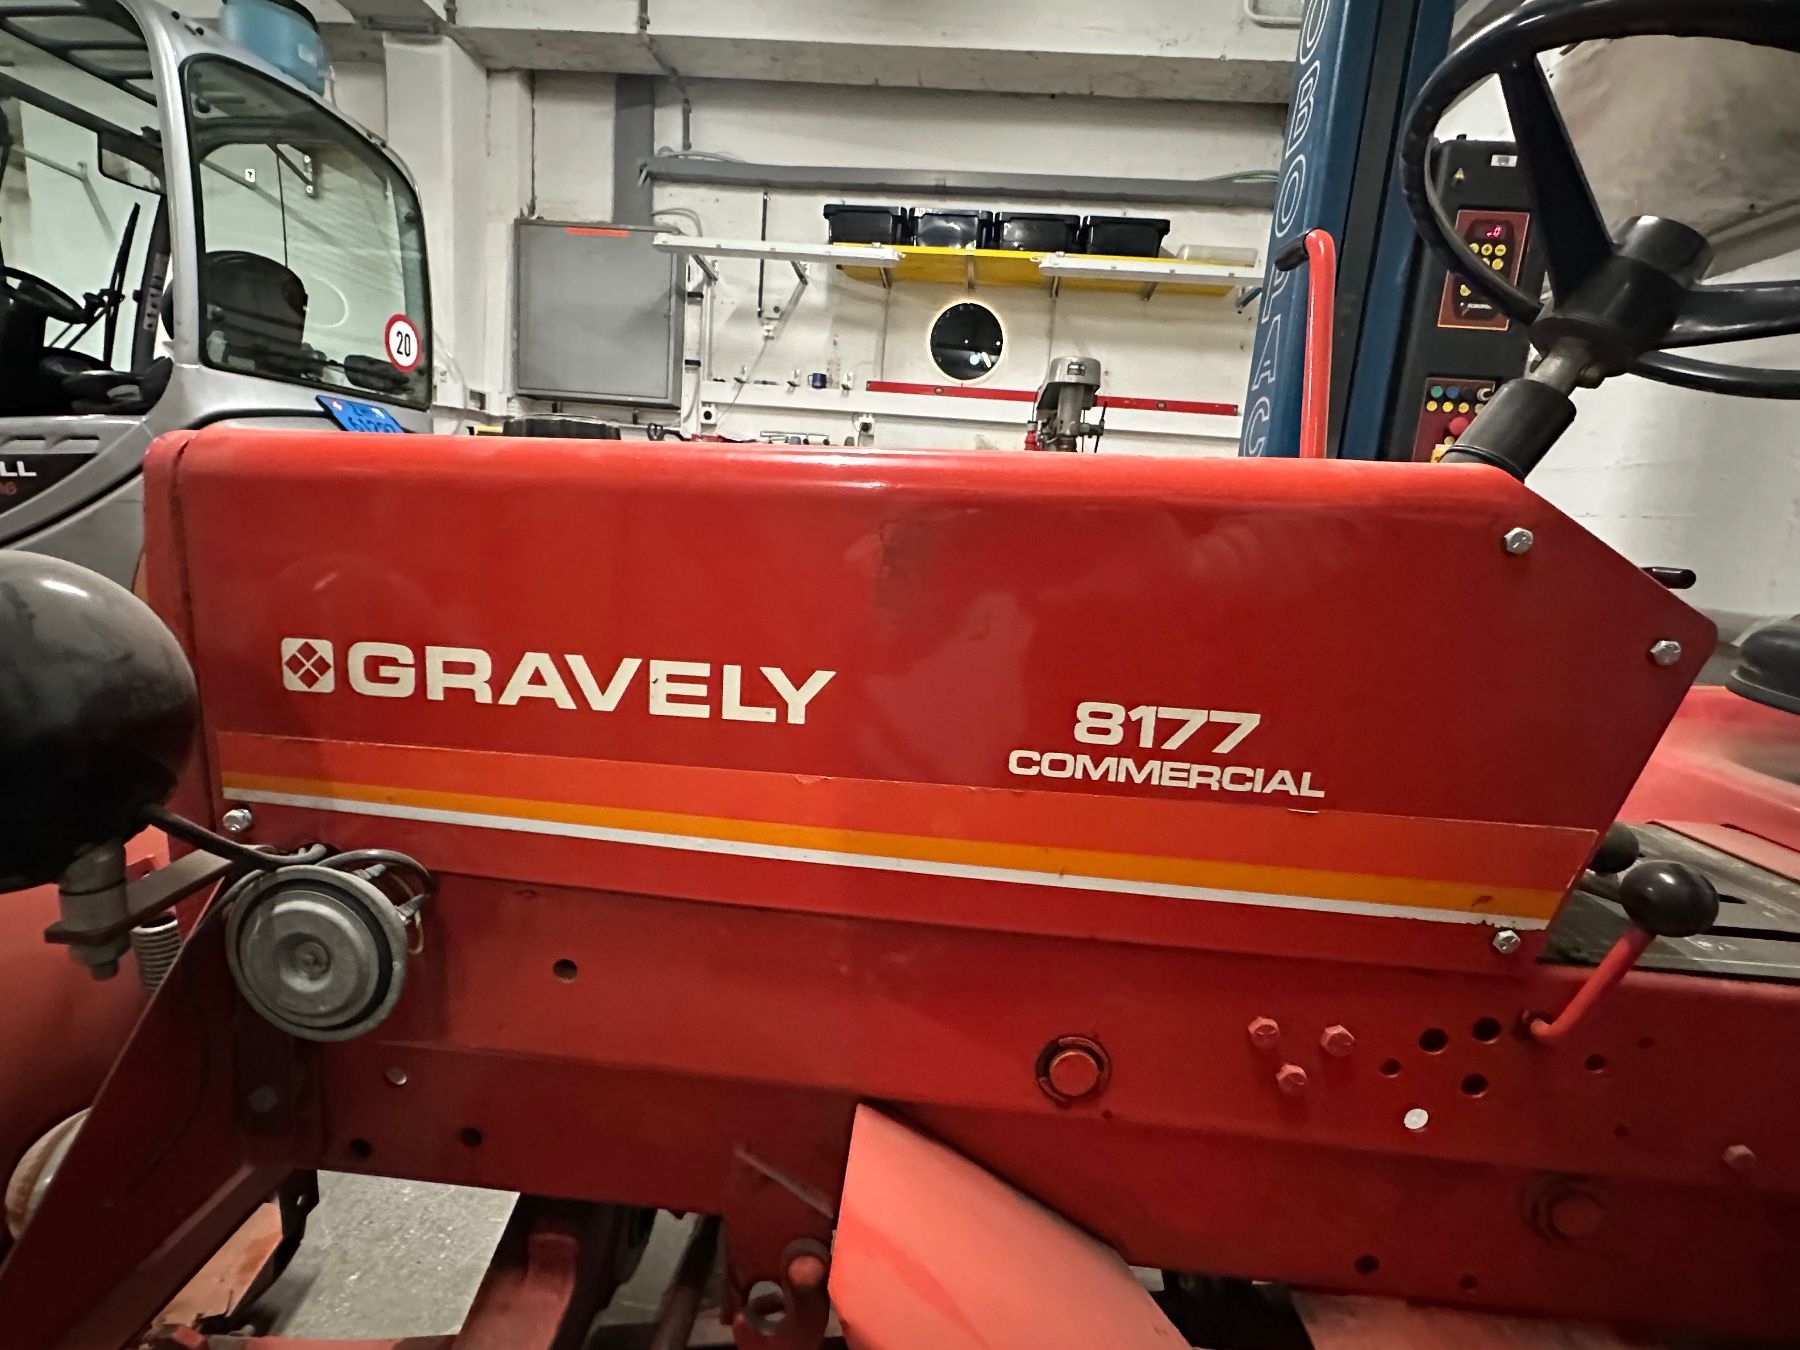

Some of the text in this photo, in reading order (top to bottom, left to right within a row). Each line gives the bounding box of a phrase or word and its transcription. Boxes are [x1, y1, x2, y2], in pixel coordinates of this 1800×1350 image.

[396, 331, 411, 357] 20
[347, 641, 837, 725] GRAVELY
[1074, 701, 1261, 754] 8177
[1008, 749, 1325, 798] COMMERCIAL
